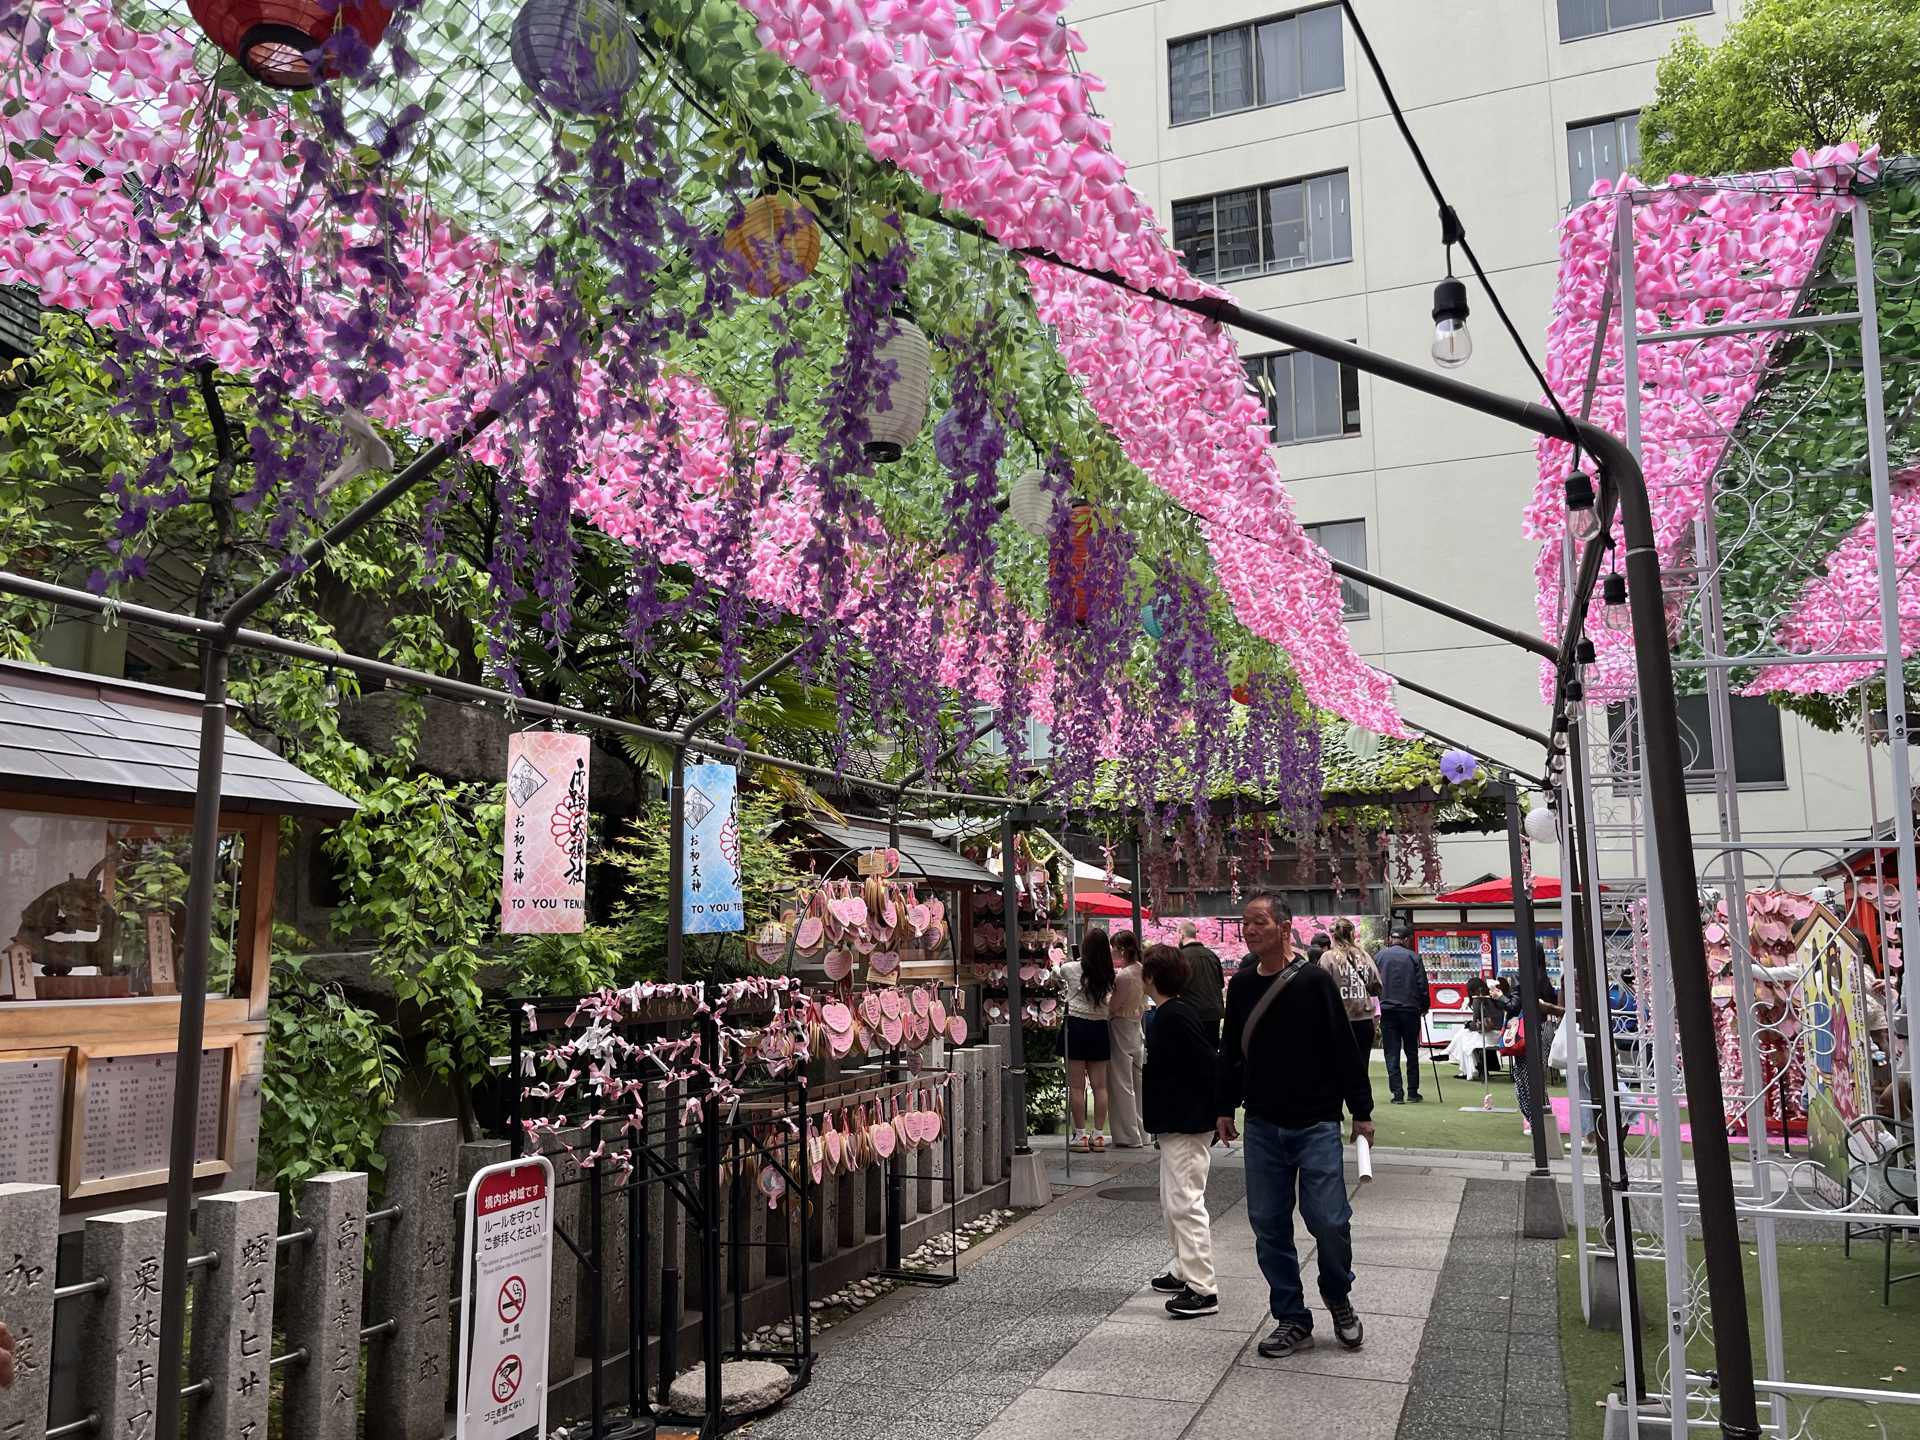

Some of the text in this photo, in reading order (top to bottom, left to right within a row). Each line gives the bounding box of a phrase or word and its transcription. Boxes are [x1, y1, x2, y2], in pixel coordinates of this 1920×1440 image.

[513, 814, 525, 885] お初天神
[689, 834, 702, 893] お初天神
[512, 899, 525, 909] TO
[532, 899, 557, 909] YOU
[692, 905, 704, 914] TO
[709, 904, 729, 913] YOU
[484, 1184, 539, 1209] 境内は神域です
[484, 1206, 541, 1234] ルールを守って
[484, 1223, 541, 1251] ご参拝ください
[484, 1398, 525, 1422] ゴミを捨てない
